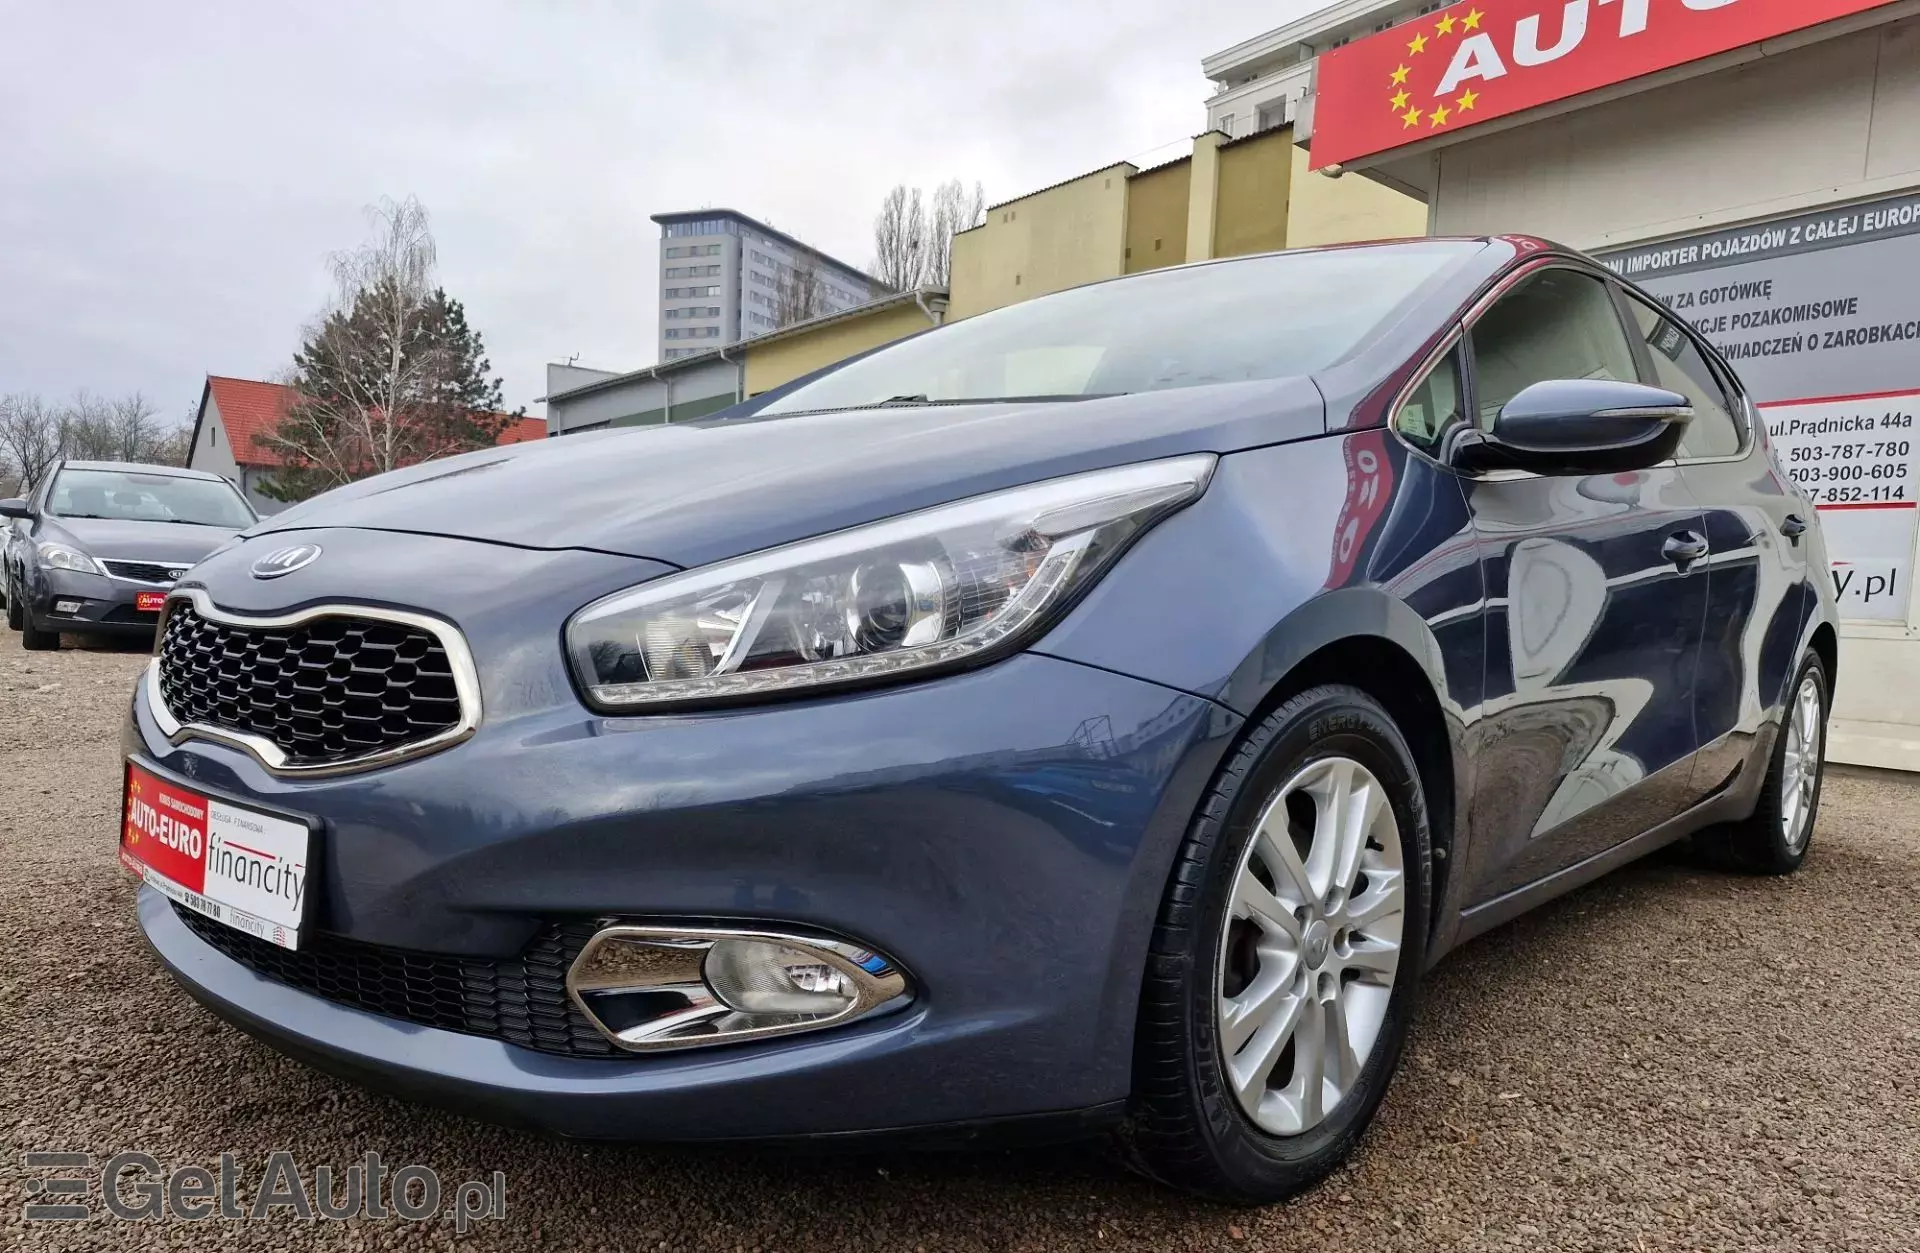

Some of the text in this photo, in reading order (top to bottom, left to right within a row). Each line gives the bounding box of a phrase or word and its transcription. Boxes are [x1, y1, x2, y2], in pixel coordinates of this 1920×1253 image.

[1433, 0, 1740, 97] AUT
[1626, 247, 1698, 273] IMPORTER
[1701, 228, 1786, 260] POJAZDÓW
[1789, 226, 1800, 244] Z
[1805, 216, 1858, 242] CAŁEJ
[1676, 292, 1694, 309] ZA
[1699, 279, 1773, 306] GOTÓWKĘ
[1731, 297, 1858, 331] POZAKOMISOWE
[1807, 333, 1818, 351] O
[1769, 411, 1912, 438] ul.Prądnicka 44a
[1790, 441, 1909, 462] 503-787-780
[1788, 463, 1908, 482] 503-900-605
[1803, 485, 1904, 502] 7-852-114
[131, 797, 202, 860] AUTO-EURO
[208, 832, 305, 911] financity
